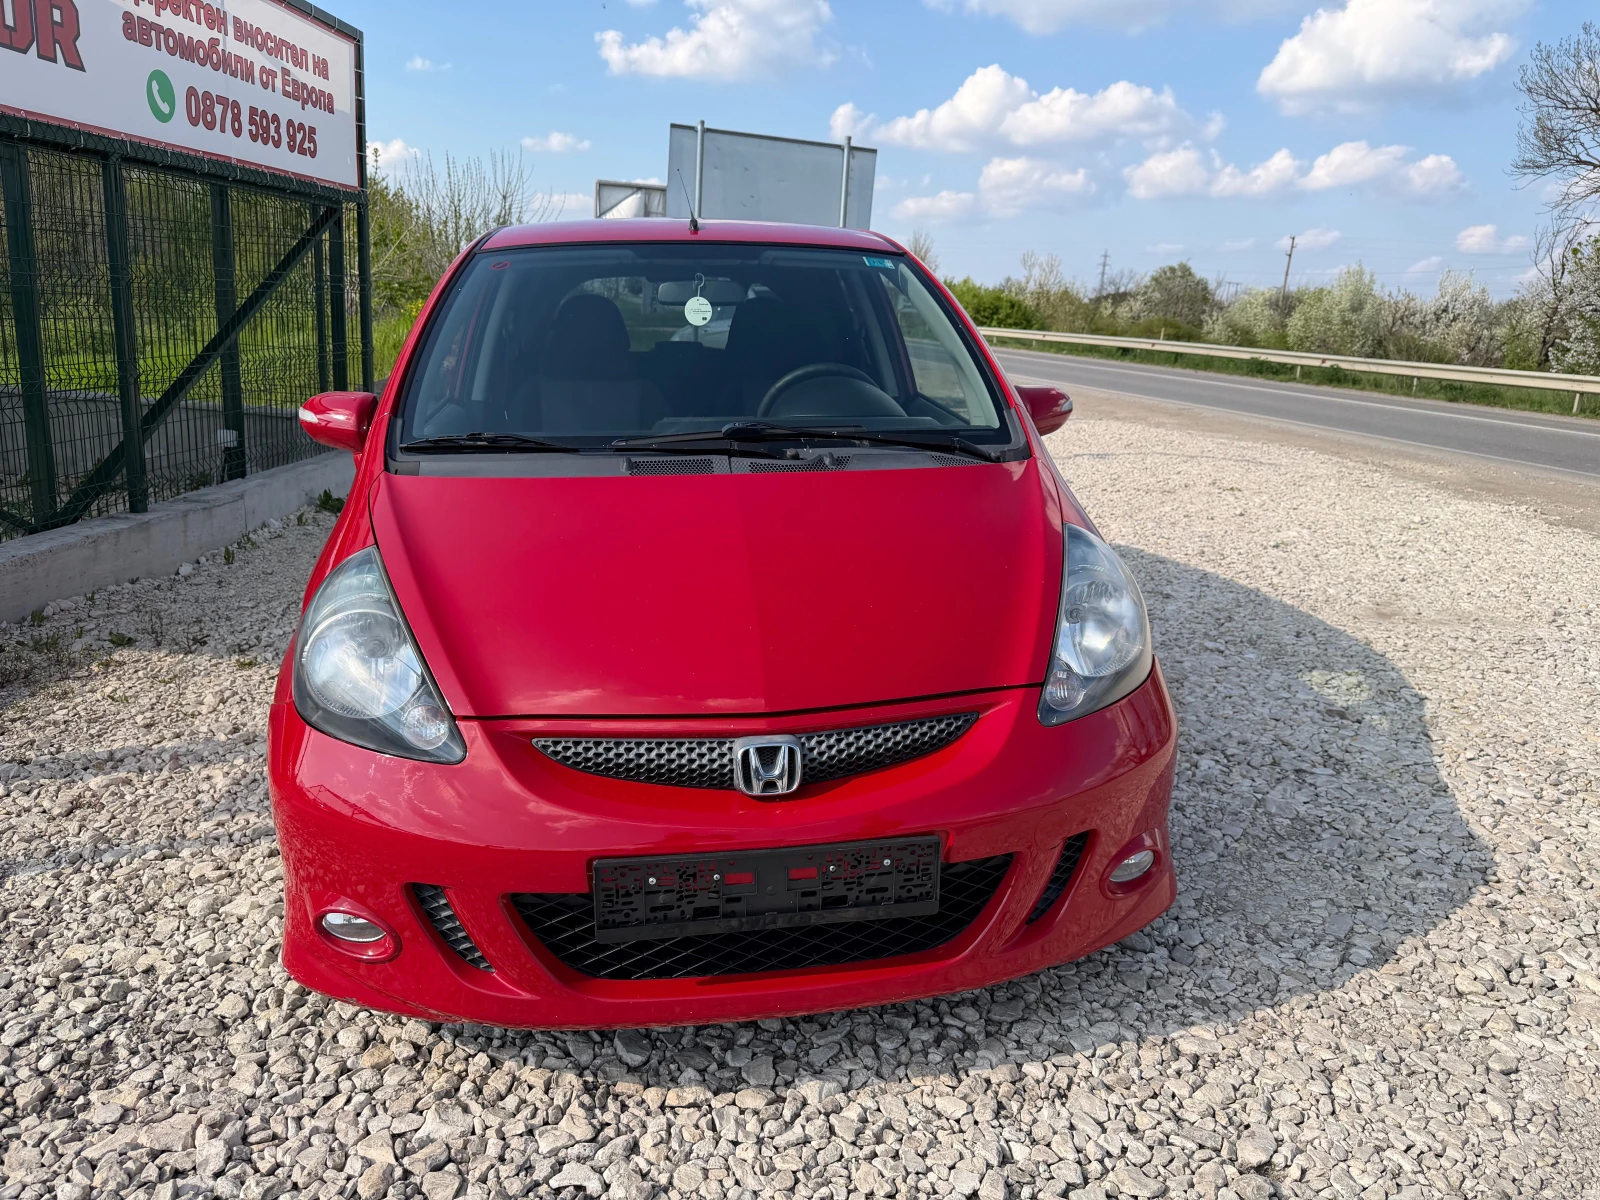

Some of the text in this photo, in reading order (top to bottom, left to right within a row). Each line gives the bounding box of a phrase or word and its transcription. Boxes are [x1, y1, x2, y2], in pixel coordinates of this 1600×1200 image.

[122, 10, 335, 115] автомобили от Европа
[233, 15, 309, 72] вносител
[312, 53, 330, 81] на
[185, 85, 318, 159] 0878 593 925
